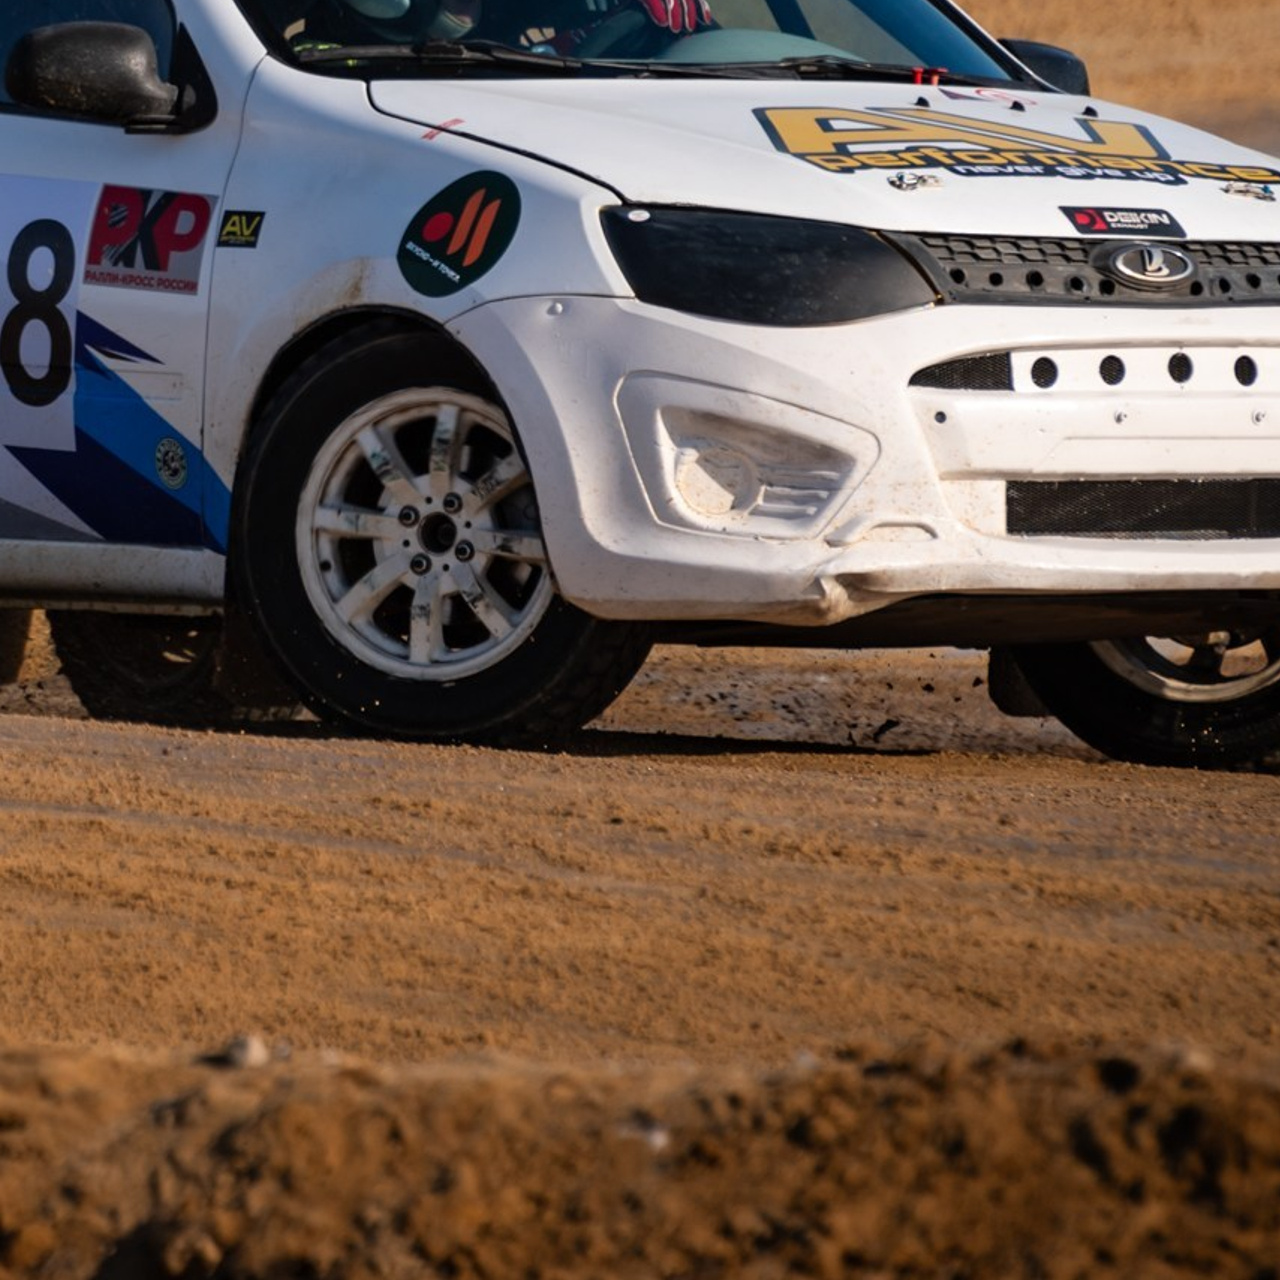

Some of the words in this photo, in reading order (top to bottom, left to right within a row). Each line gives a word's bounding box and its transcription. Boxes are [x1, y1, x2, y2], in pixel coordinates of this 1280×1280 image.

[810, 147, 1279, 182] performance
[954, 165, 1045, 175] never
[1054, 165, 1127, 177] give
[1131, 169, 1175, 182] up
[222, 215, 261, 236] AV
